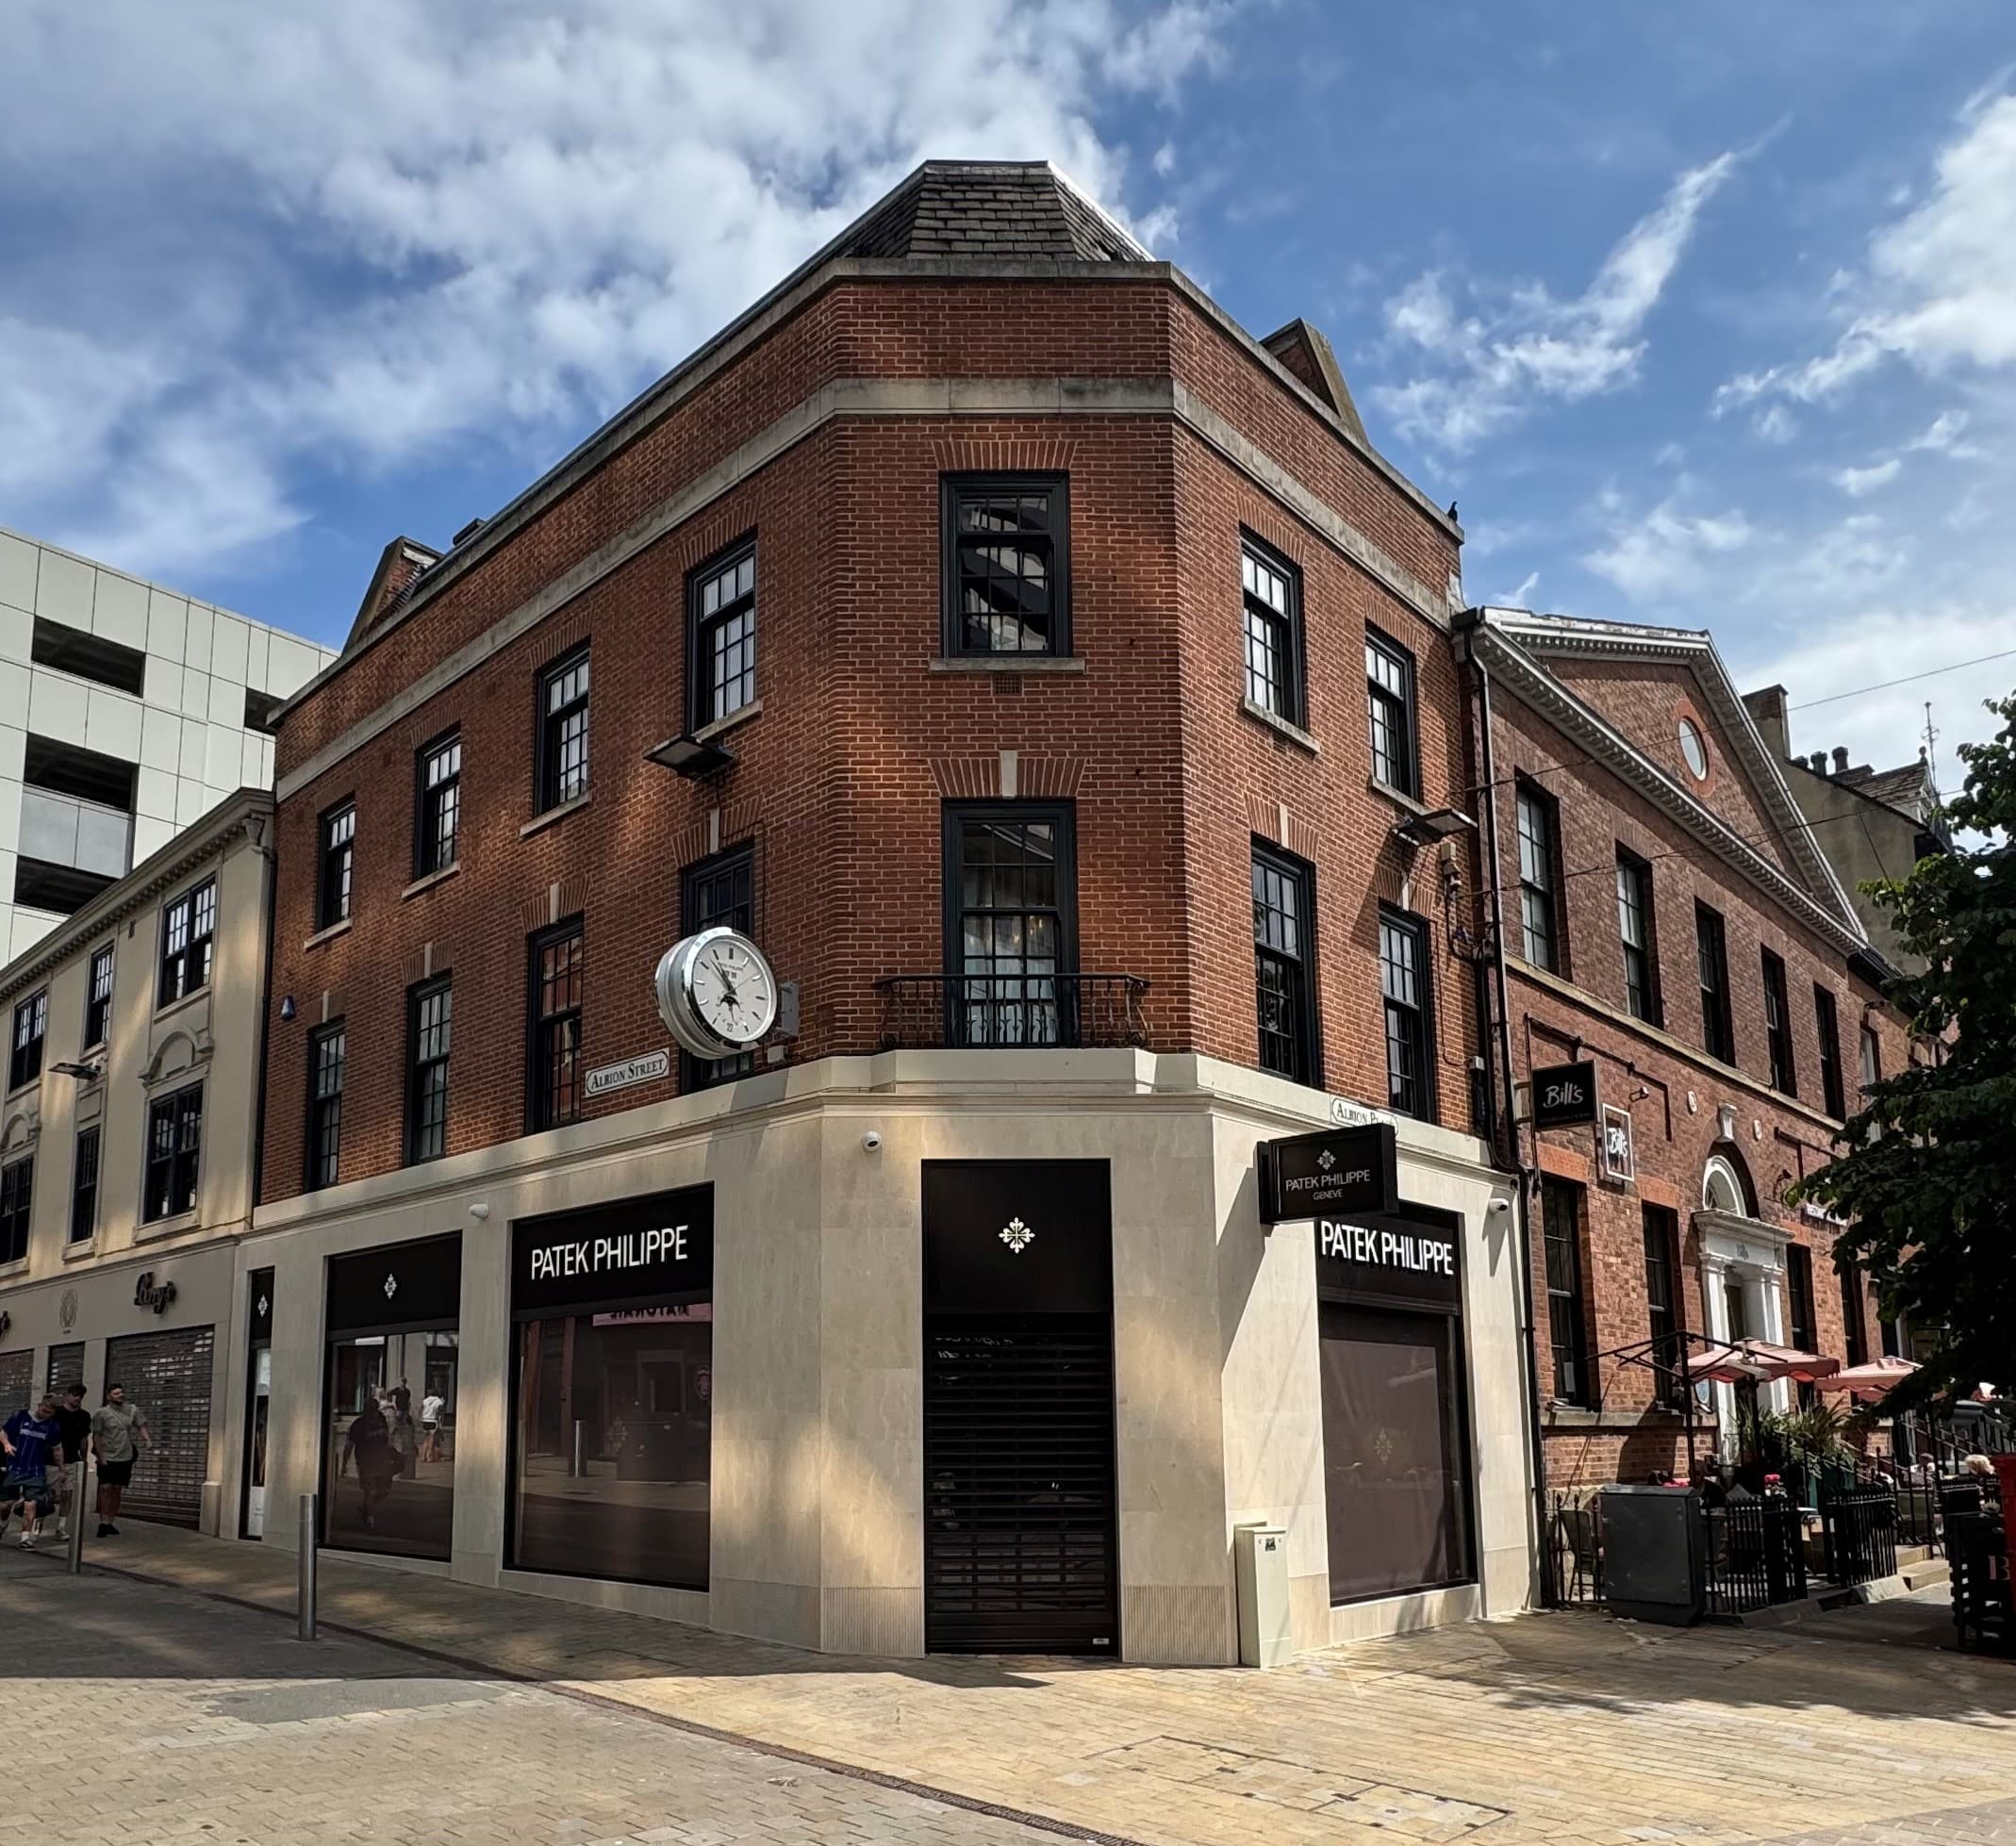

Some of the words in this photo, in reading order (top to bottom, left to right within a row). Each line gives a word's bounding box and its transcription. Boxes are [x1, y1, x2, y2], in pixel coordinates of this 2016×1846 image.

[591, 1070, 626, 1090] ALBION
[628, 1059, 664, 1079] STREET
[1543, 1081, 1583, 1108] Bill's
[1337, 1102, 1367, 1125] ALBION
[1285, 1176, 1319, 1192] PATEK
[1321, 1169, 1371, 1187] PHILIPPE
[531, 1241, 589, 1280] PATEK
[594, 1225, 688, 1272] PHILIPPE
[1320, 1220, 1379, 1263] PATEK
[1381, 1231, 1454, 1275] PHILIPPE
